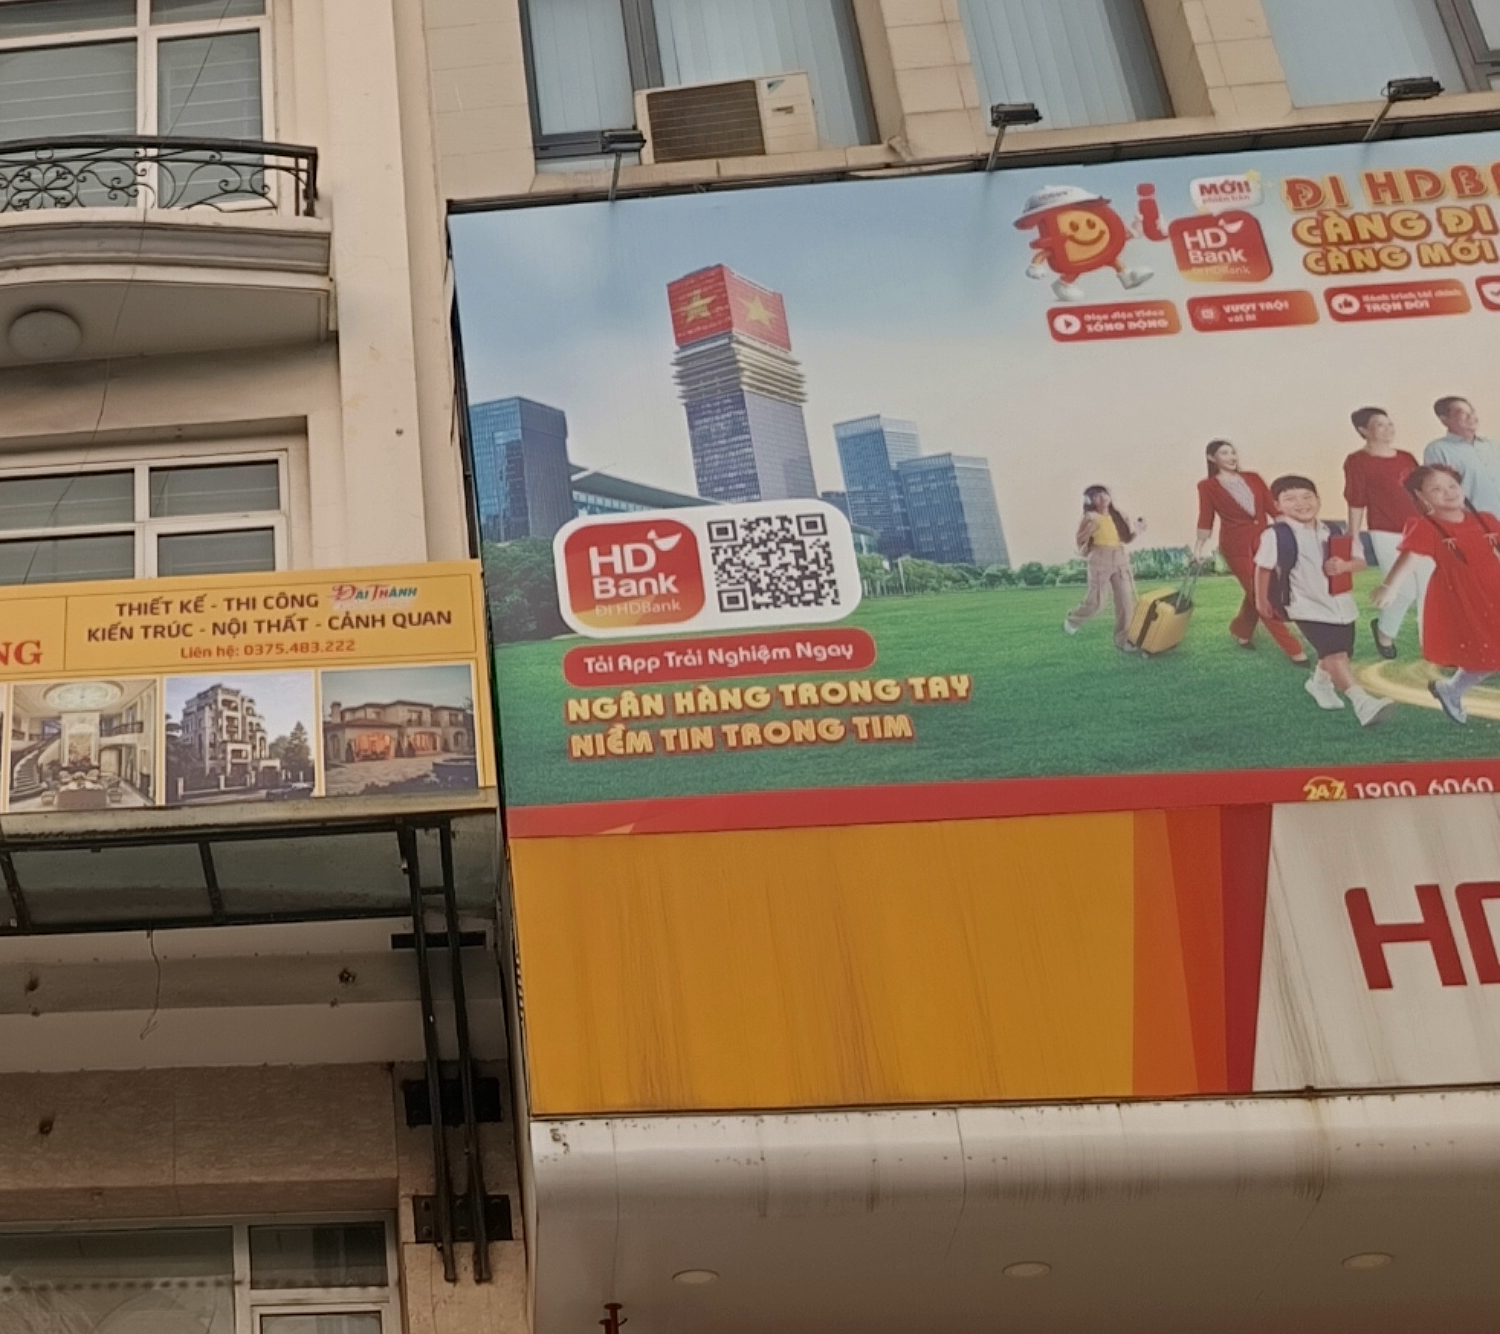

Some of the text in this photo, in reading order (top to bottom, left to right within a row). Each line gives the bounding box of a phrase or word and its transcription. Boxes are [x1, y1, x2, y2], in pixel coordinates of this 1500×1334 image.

[1285, 163, 1500, 211] ĐI HDB
[1183, 227, 1228, 251] HD
[1294, 204, 1498, 247] CÀNG ĐI
[1188, 246, 1247, 265] Bank
[1304, 236, 1499, 275] CÀNG MỚI
[589, 542, 656, 576] HD
[593, 573, 679, 600] Bank
[114, 590, 319, 619] THIẾT KẾ THI CÔNG
[617, 598, 682, 617] HDBank
[87, 607, 453, 643] KIẾN TRÚC NỘI THẤT CẢNH QUAN
[180, 639, 356, 659] Liên hệ: 0375.483.222
[583, 640, 854, 675] Tải App Trải Nghiệm Ngay
[567, 673, 972, 724] NGÂN HÀNG TRONG TAY
[569, 713, 914, 760] NIỀM TIN TRONG TIM
[1353, 779, 1418, 799] 1900
